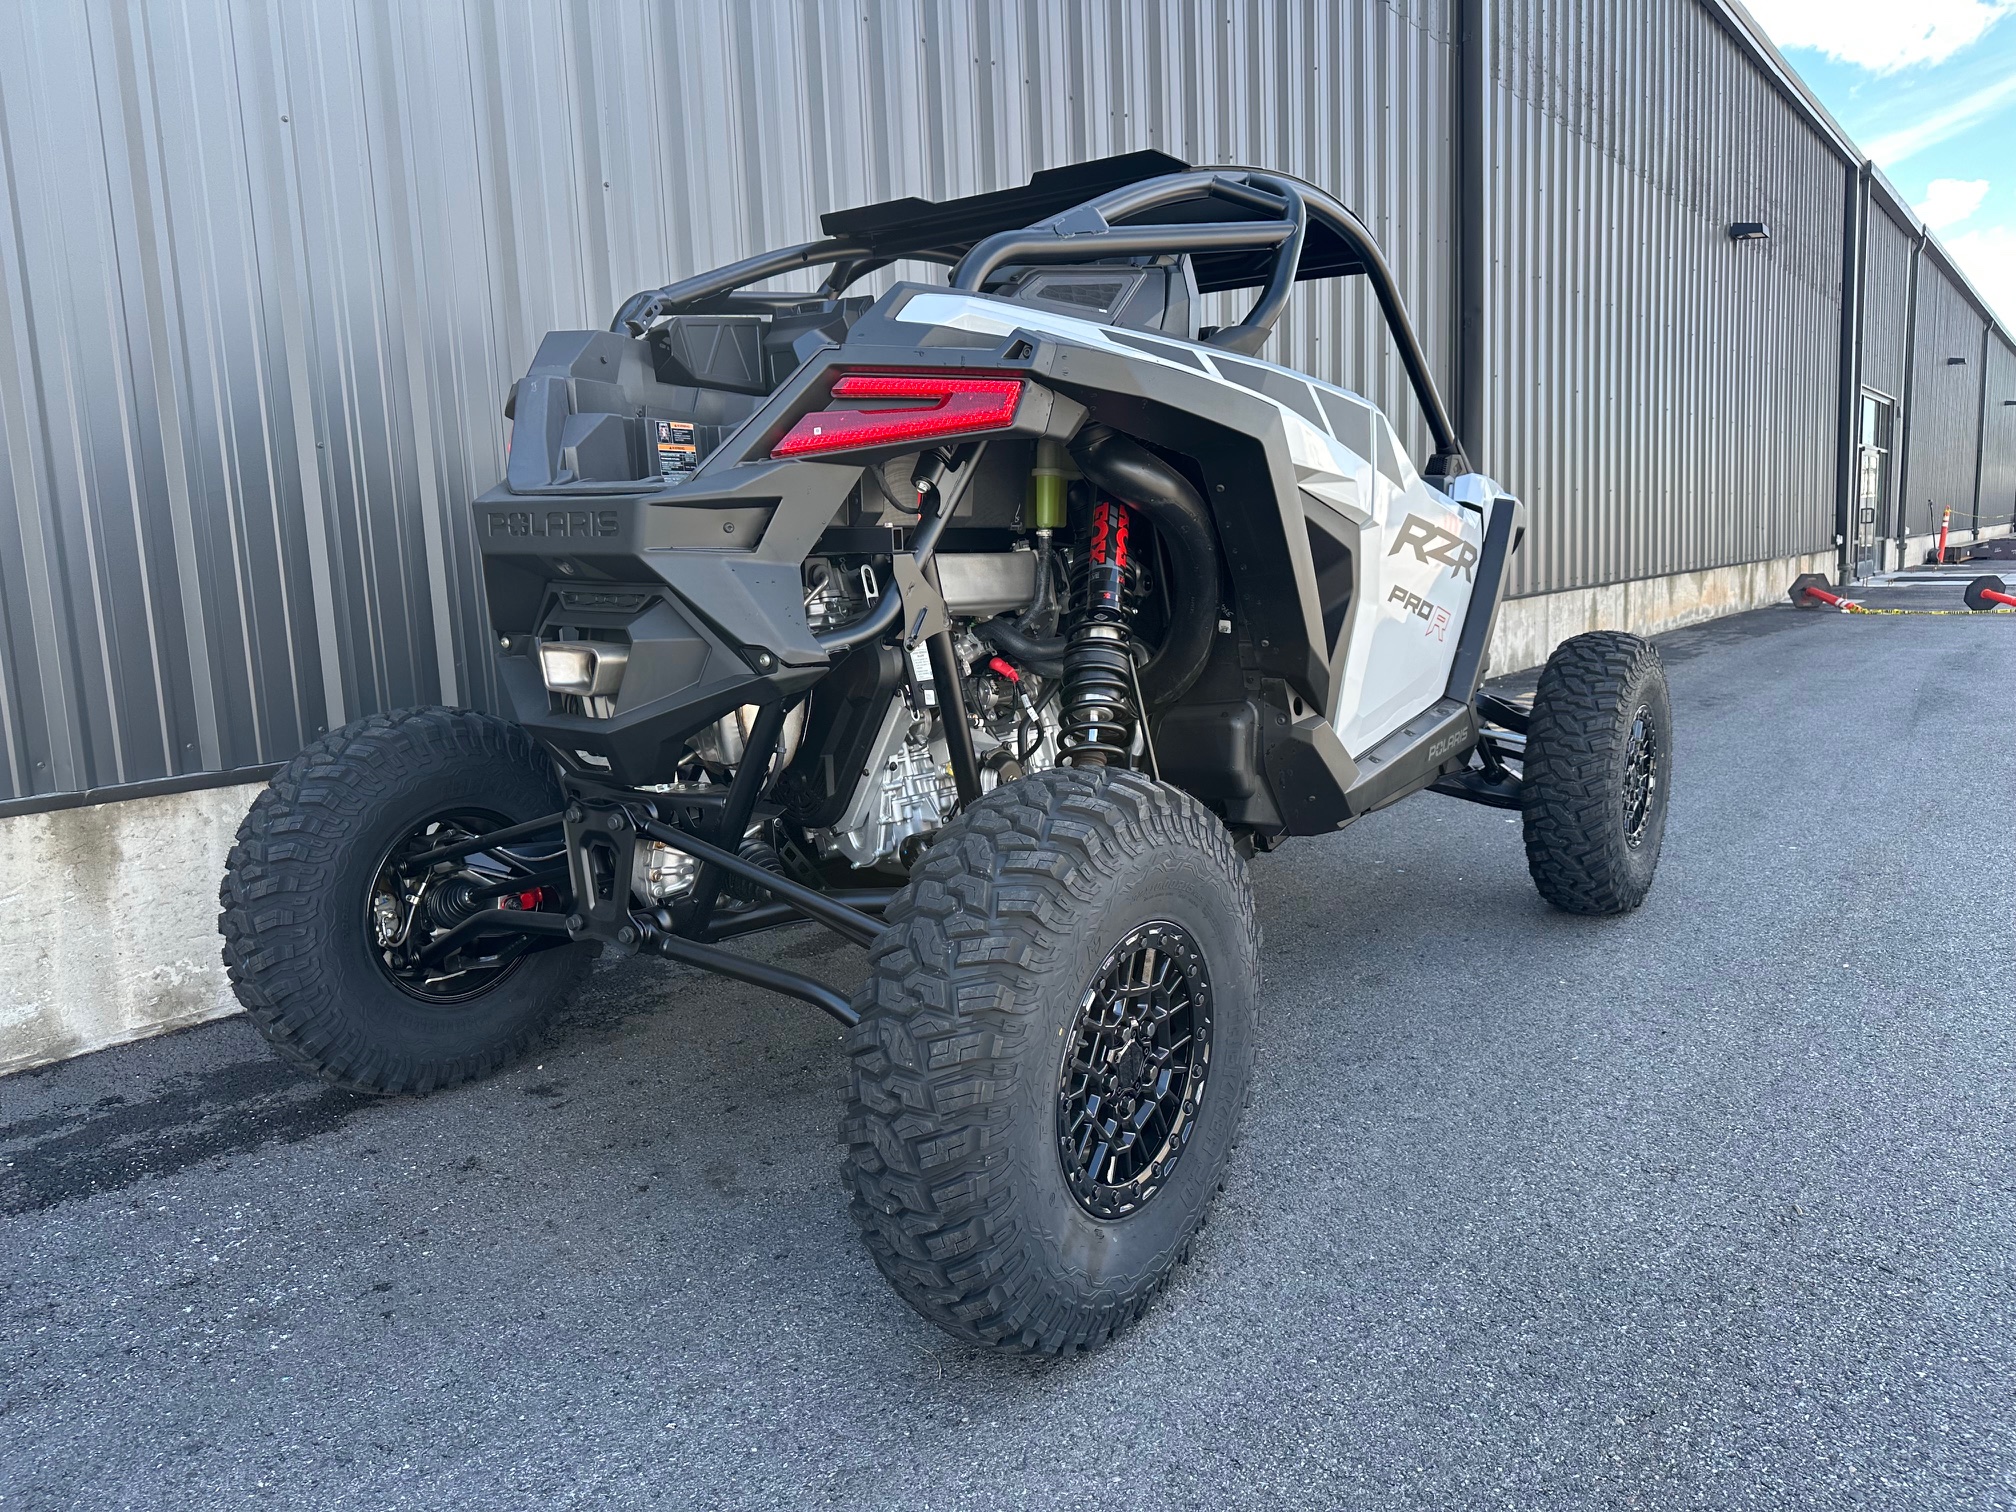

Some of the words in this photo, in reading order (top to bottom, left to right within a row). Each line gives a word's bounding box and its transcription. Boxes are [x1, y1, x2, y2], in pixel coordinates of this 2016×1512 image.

[487, 510, 620, 537] POLARIS
[1387, 512, 1478, 584] RZR
[1387, 584, 1434, 621] PRO
[1425, 605, 1451, 642] R
[1428, 726, 1468, 761] POLARIS
